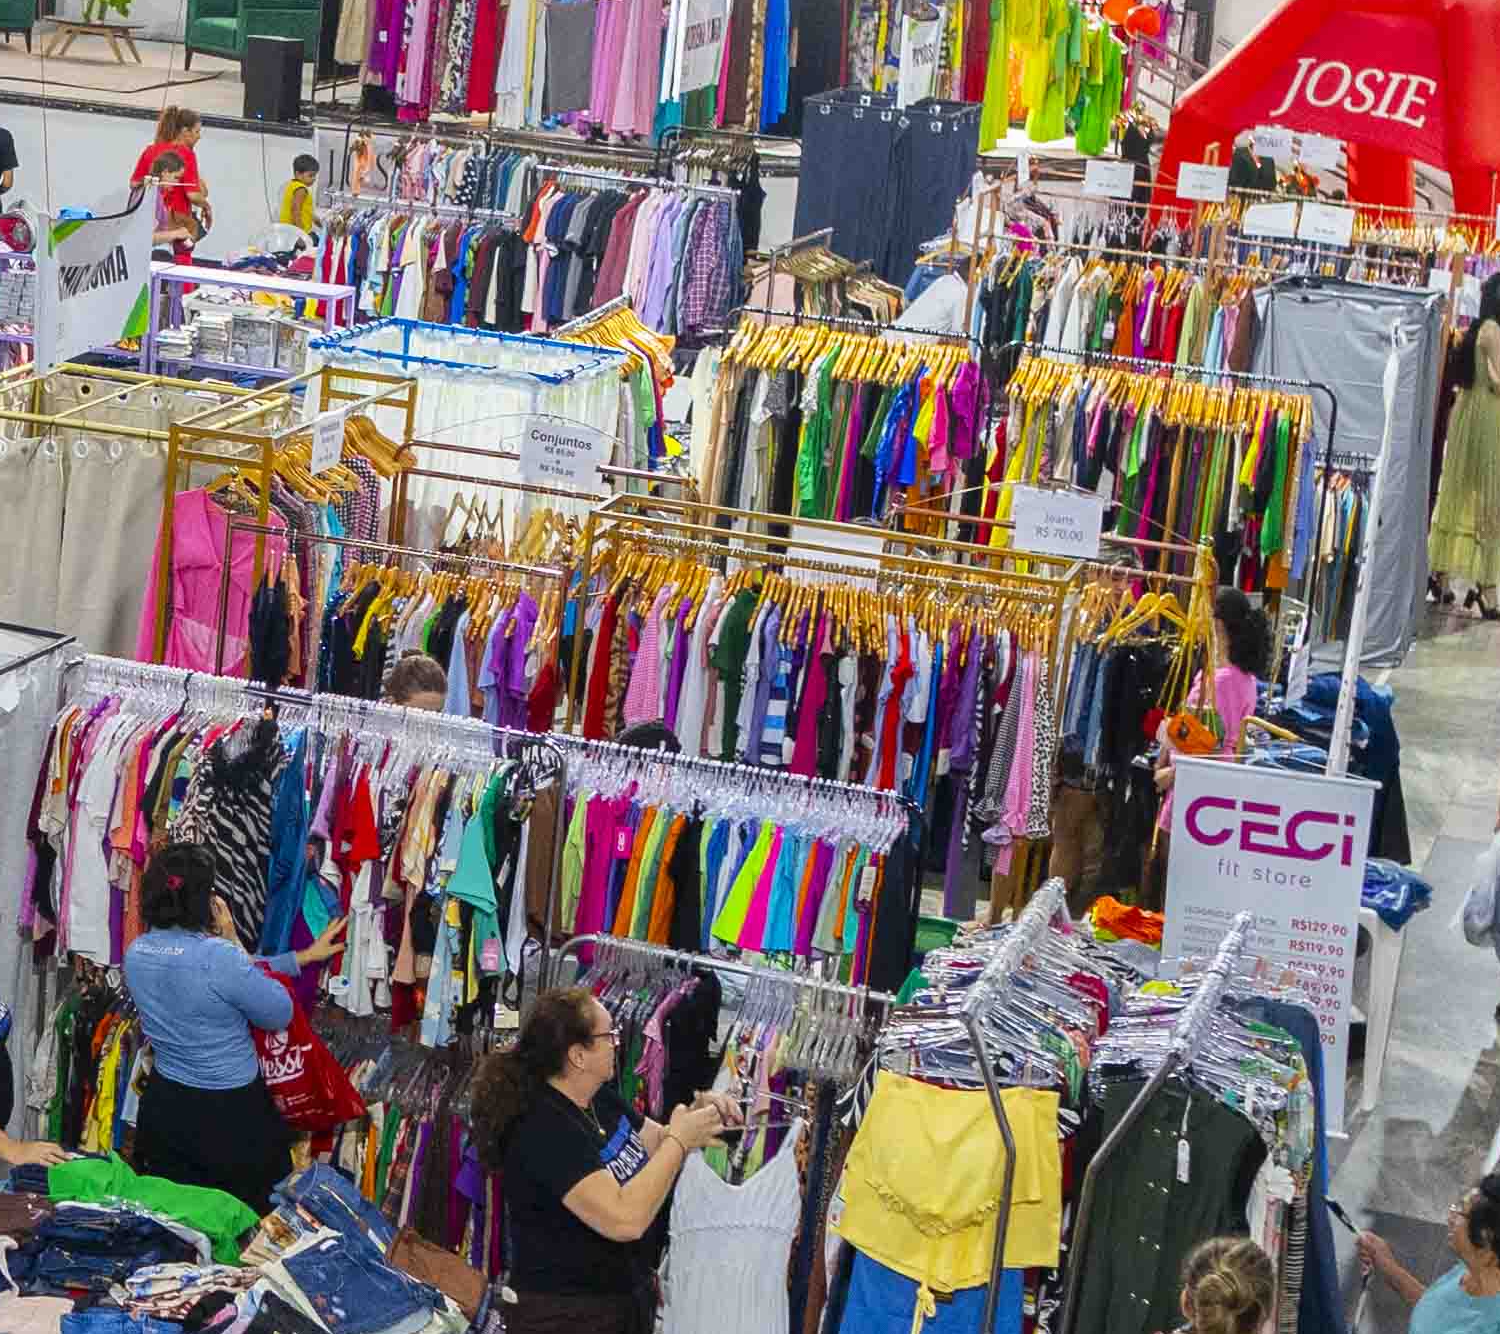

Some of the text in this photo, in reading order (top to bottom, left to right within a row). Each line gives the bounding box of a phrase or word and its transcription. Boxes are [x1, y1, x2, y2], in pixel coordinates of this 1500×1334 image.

[1269, 57, 1438, 129] JOSIE
[531, 429, 593, 451] Conjuntos
[1216, 858, 1313, 889] fit store
[1291, 918, 1349, 937] R$129,90
[1289, 939, 1345, 957] R$119,90
